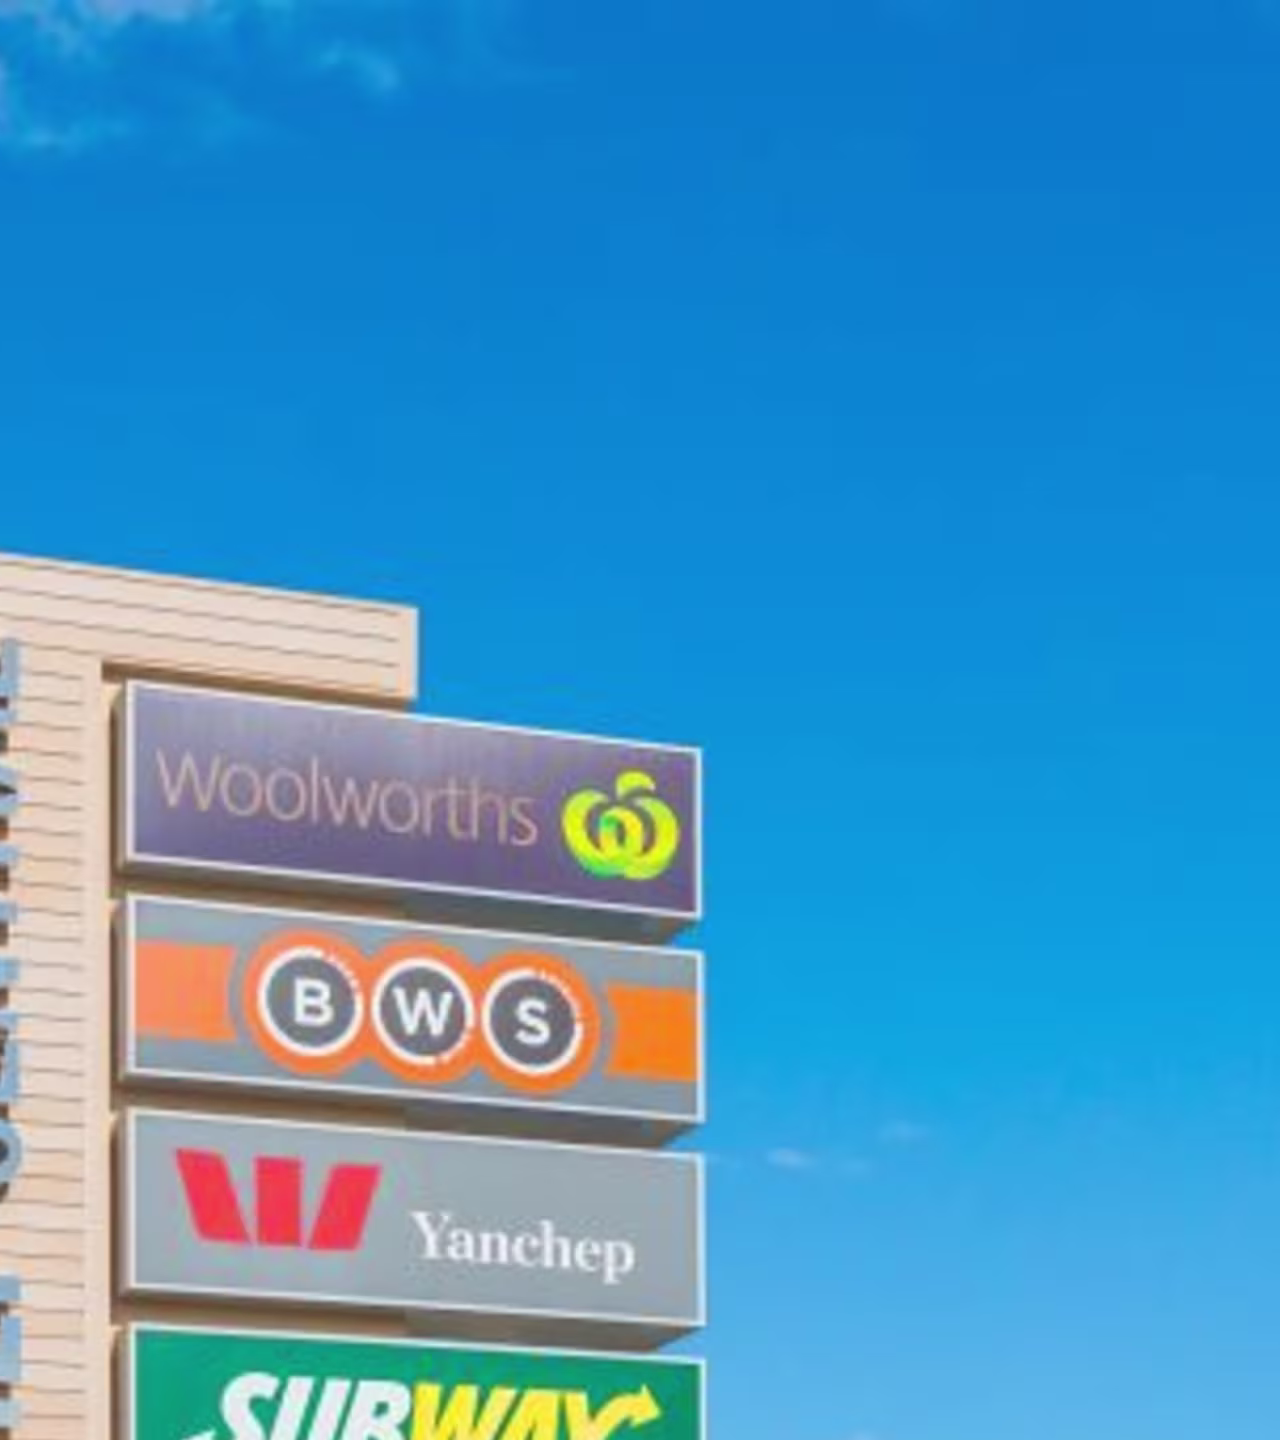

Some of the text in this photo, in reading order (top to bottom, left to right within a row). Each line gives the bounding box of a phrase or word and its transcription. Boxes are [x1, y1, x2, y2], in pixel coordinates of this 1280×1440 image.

[156, 748, 539, 847] Woolworths
[293, 976, 552, 1047] BWS
[410, 1209, 636, 1284] Yanchep
